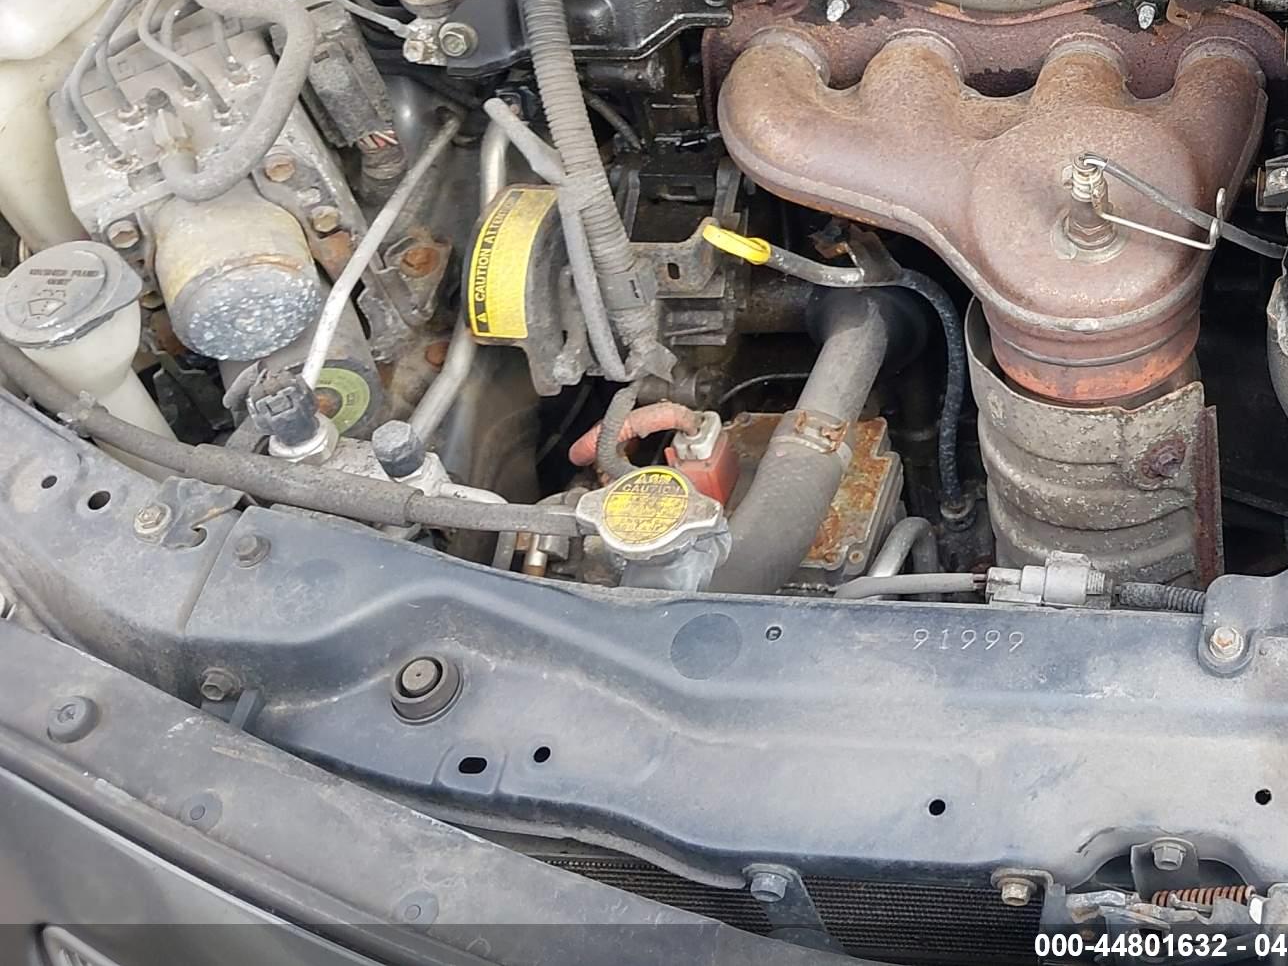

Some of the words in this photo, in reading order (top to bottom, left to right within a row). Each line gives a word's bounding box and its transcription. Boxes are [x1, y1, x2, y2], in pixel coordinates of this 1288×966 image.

[474, 247, 490, 302] CAUTION
[622, 484, 680, 494] CAUTION
[912, 628, 1025, 653] 91999
